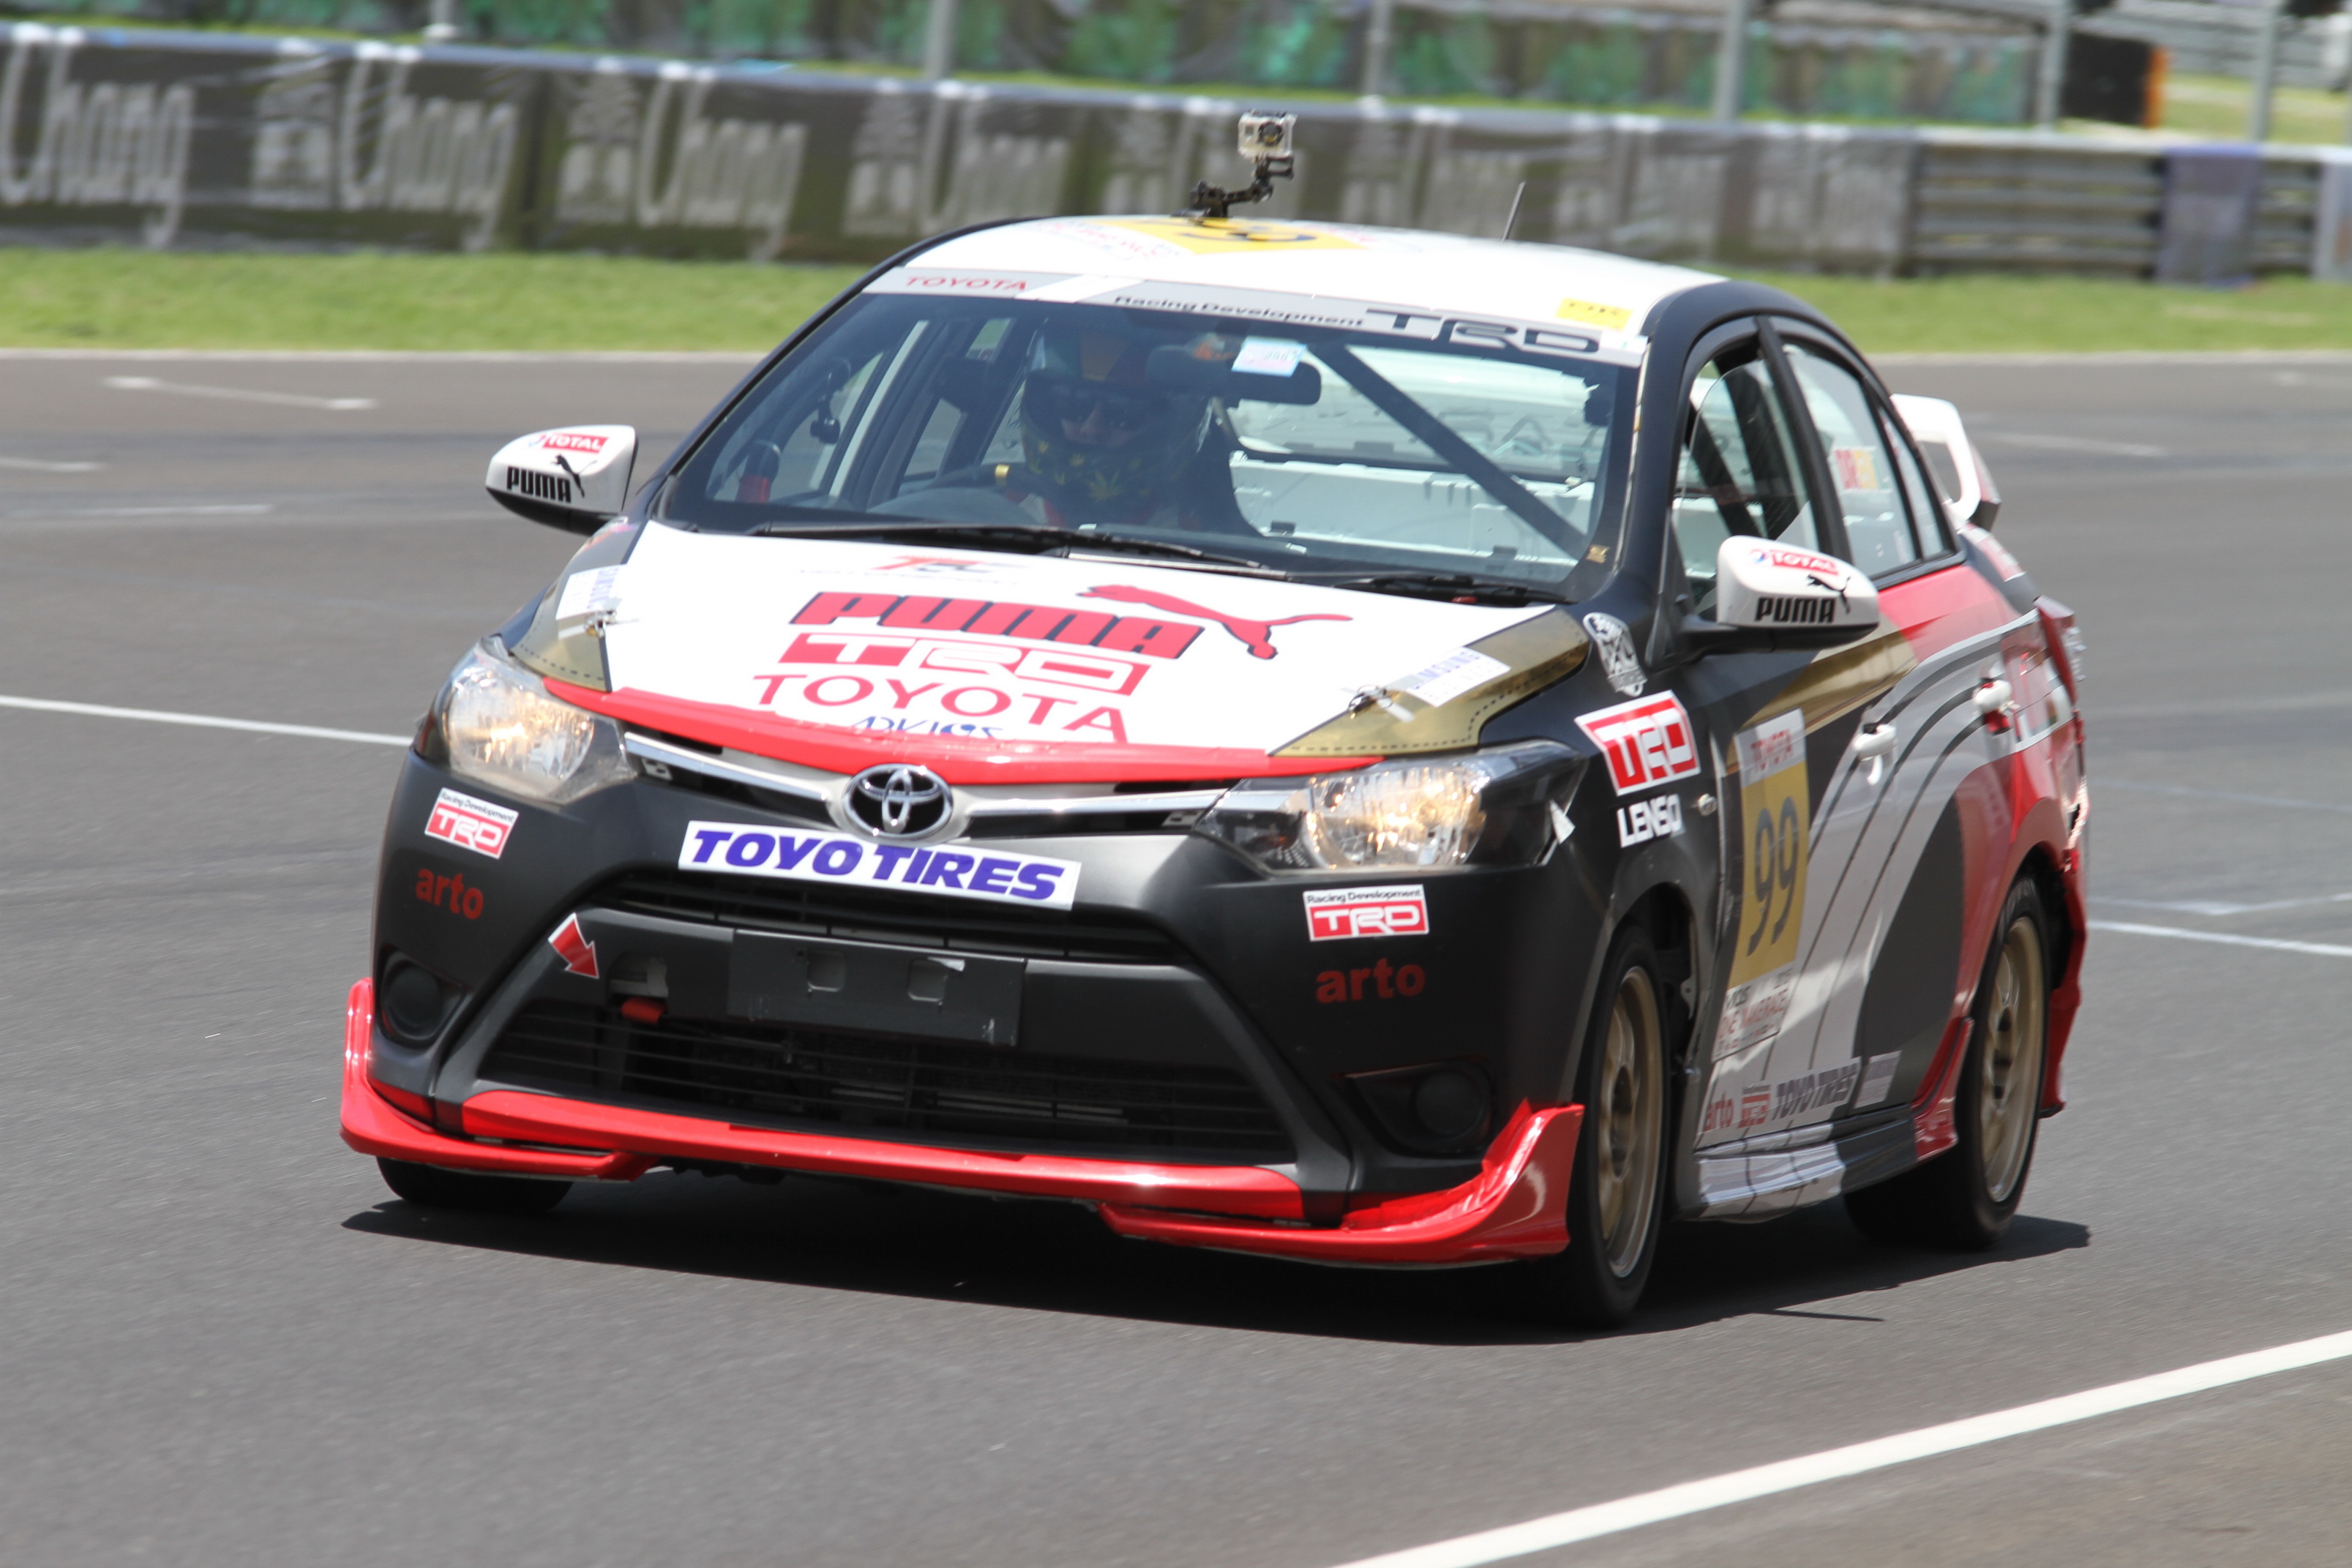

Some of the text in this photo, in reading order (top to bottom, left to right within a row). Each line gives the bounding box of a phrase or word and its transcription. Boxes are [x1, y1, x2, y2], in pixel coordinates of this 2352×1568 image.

[906, 275, 1027, 292] TOYOTA
[1114, 295, 1196, 315] Racing
[1202, 302, 1363, 326] Development
[1366, 308, 1600, 353] TRD
[549, 435, 602, 451] TOTAL
[506, 466, 572, 503] PUMA
[789, 591, 1205, 659] PUMA
[1755, 597, 1837, 623] PUMA
[798, 634, 1143, 693] TRD
[753, 675, 1128, 744] TOYOTA
[441, 792, 514, 822] Racing Development
[435, 809, 503, 850] TRD
[692, 830, 1065, 900] TOYO TIRES
[1746, 796, 1799, 958] 99
[415, 868, 484, 921] arto
[1306, 888, 1423, 904] Racing Development
[1314, 904, 1420, 937] TRD
[1316, 958, 1426, 1005] arto
